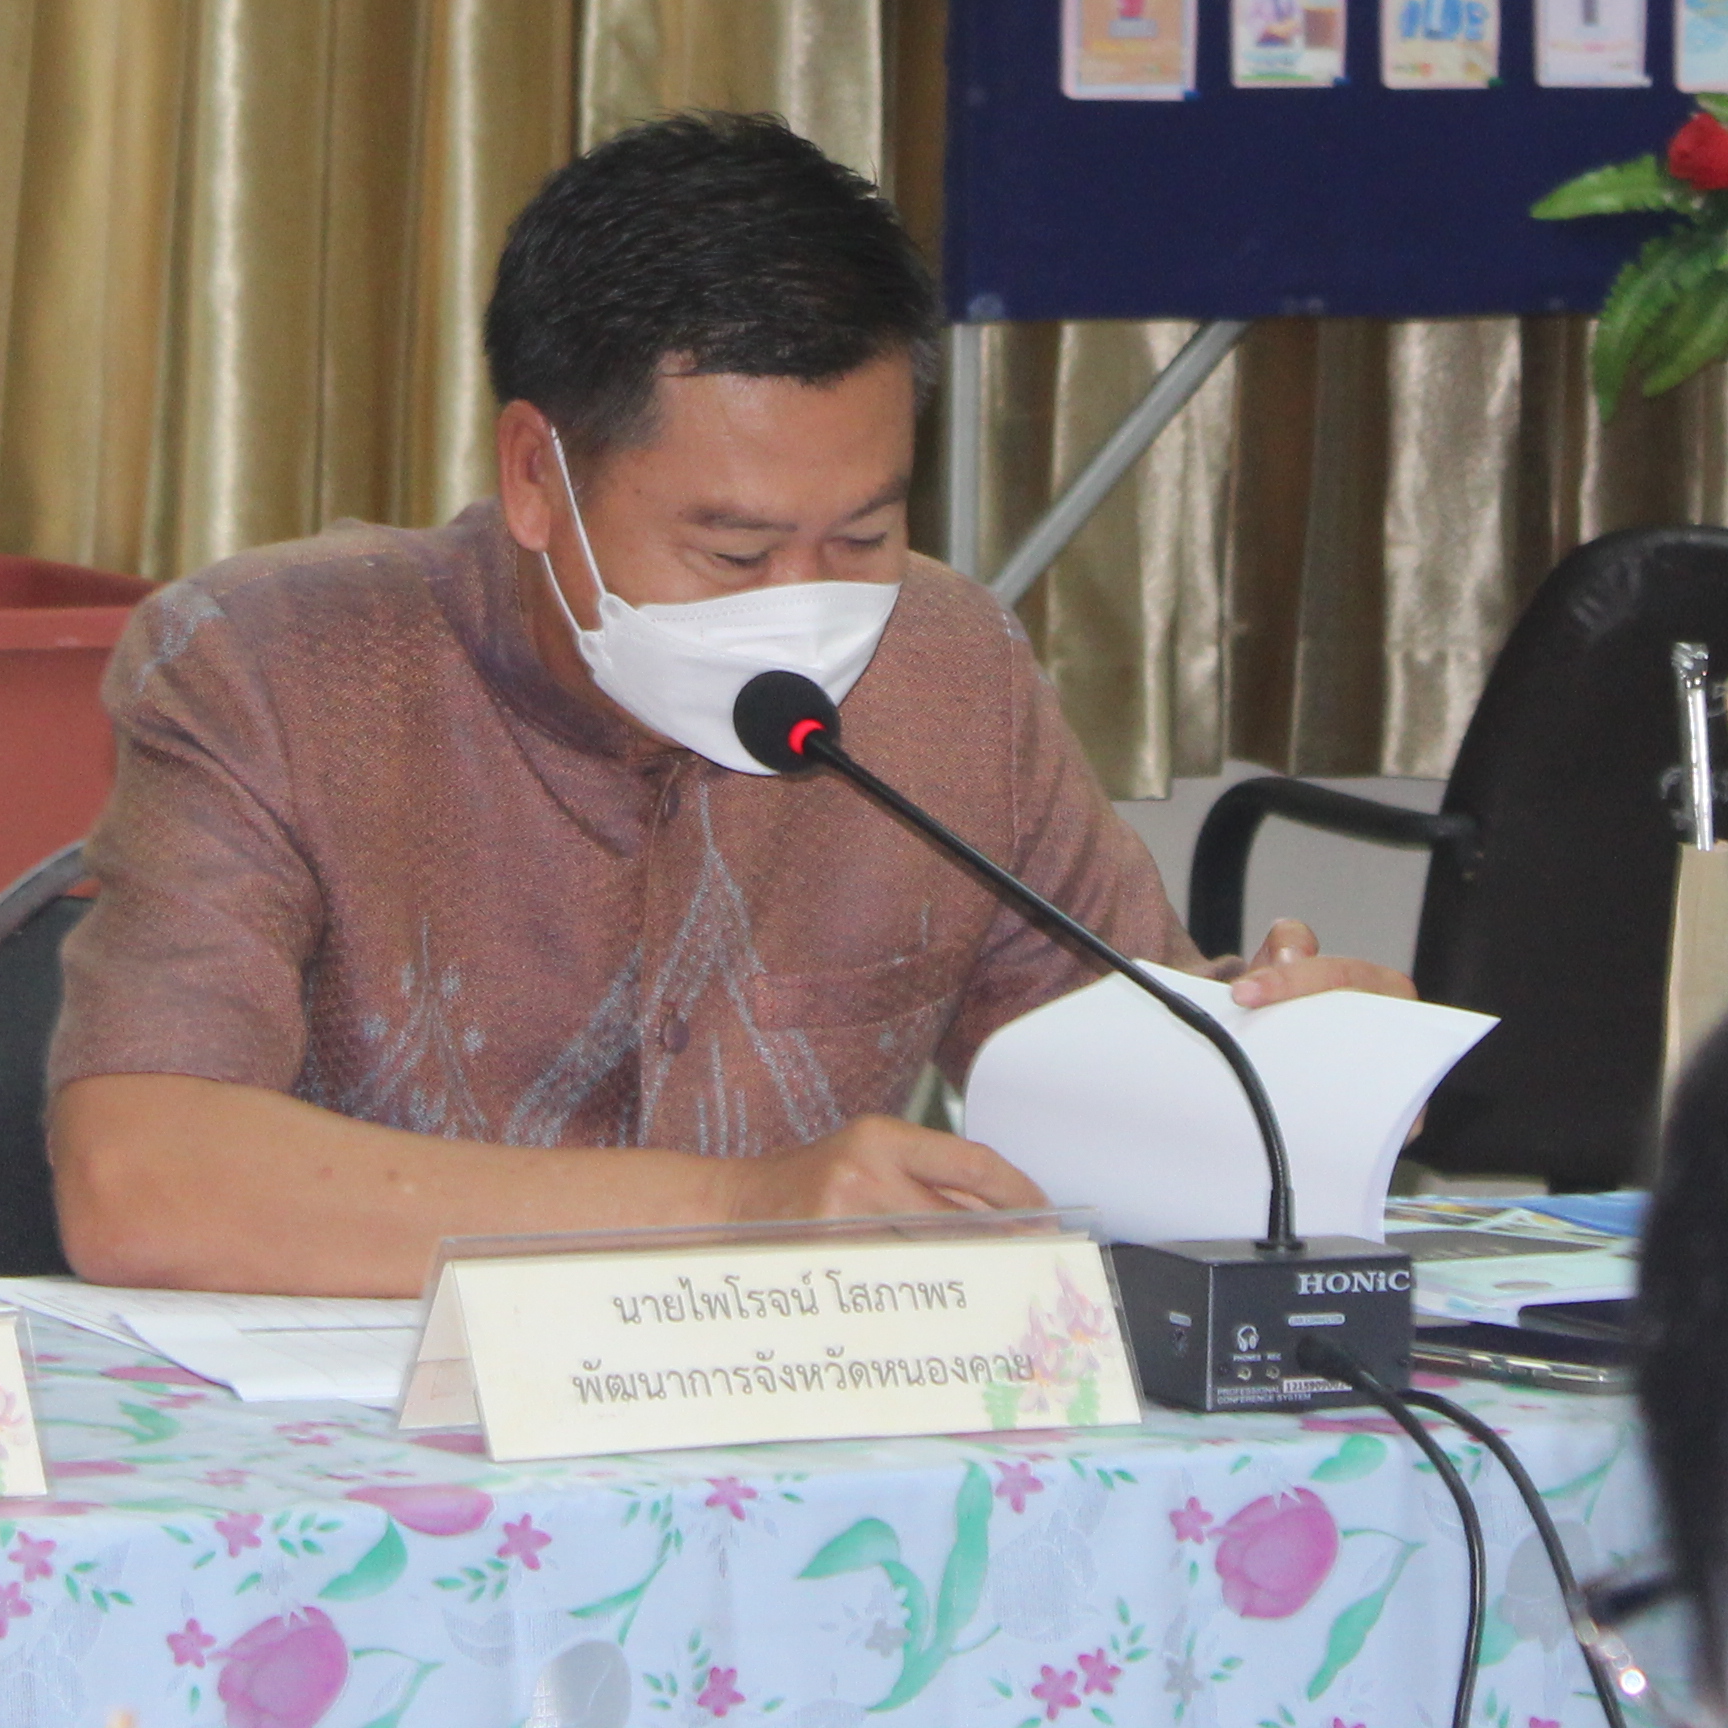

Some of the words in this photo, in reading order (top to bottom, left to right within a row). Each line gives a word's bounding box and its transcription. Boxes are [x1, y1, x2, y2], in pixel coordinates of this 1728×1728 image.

[612, 1270, 820, 1325] นายไพโรจน์
[825, 1269, 968, 1314] โสภาพร
[572, 1346, 1036, 1405] พัฒนาการจังหวัดหนองคาย
